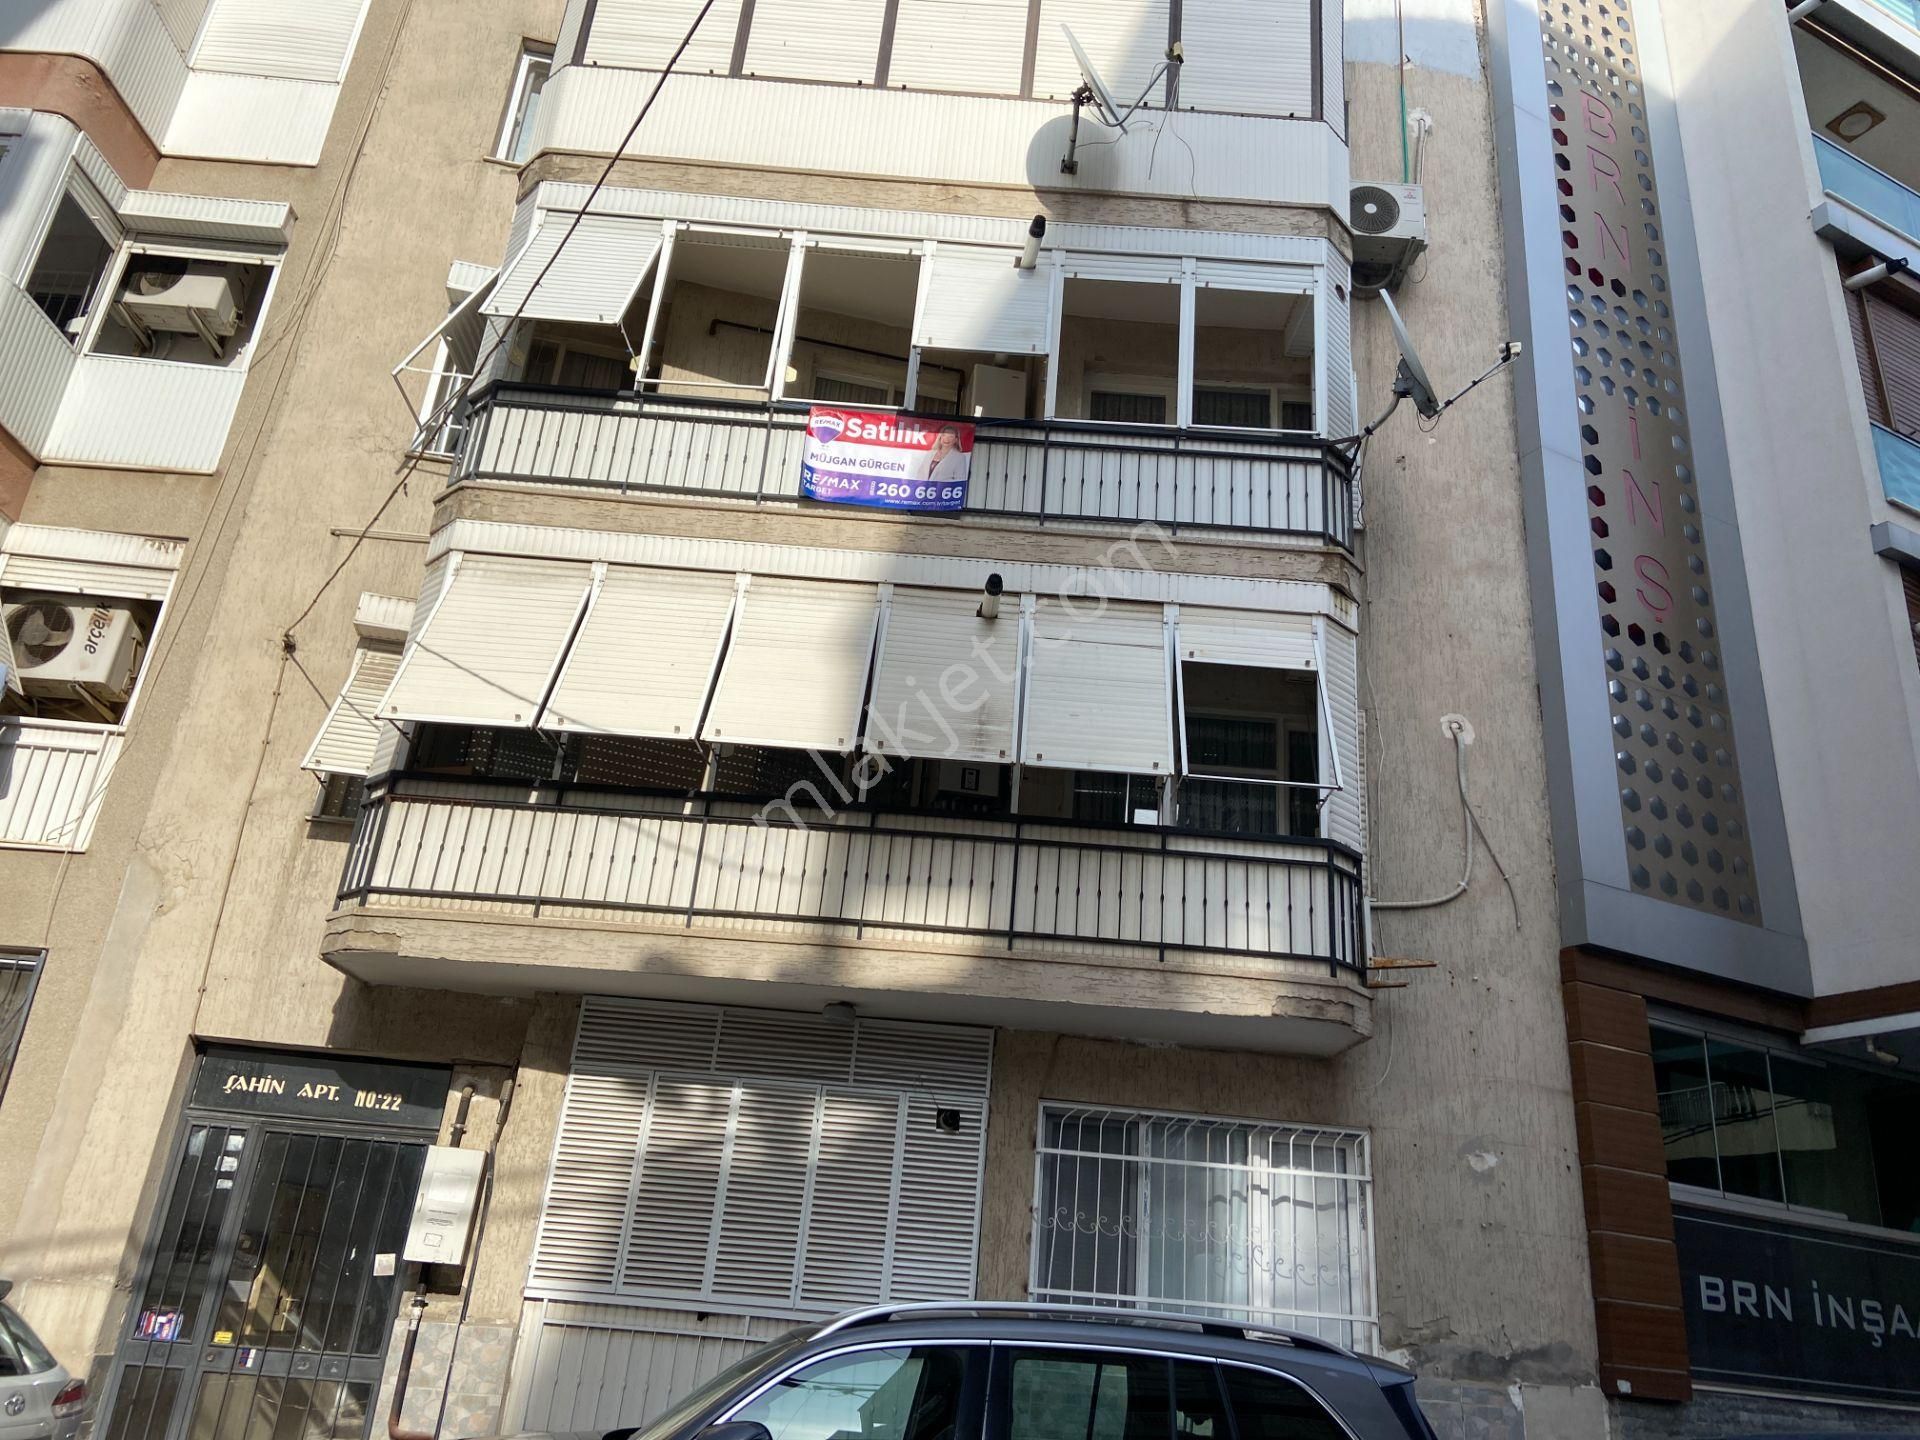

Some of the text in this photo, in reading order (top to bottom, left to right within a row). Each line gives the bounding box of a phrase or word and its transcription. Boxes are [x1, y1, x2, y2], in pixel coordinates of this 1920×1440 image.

[1580, 90, 1631, 273] BRN
[845, 418, 929, 446] Satılık
[810, 452, 906, 472] MÜJGAN GÜRGEN
[803, 469, 860, 491] RE/MAX
[803, 479, 832, 496] TARGET
[876, 482, 911, 498] 260
[914, 486, 937, 500] 66
[941, 486, 963, 500] 66
[84, 602, 112, 655] arçelik
[222, 1074, 403, 1112] ŞAHİN APT. NO:22
[1699, 1274, 1920, 1348] BRN İNŞA
